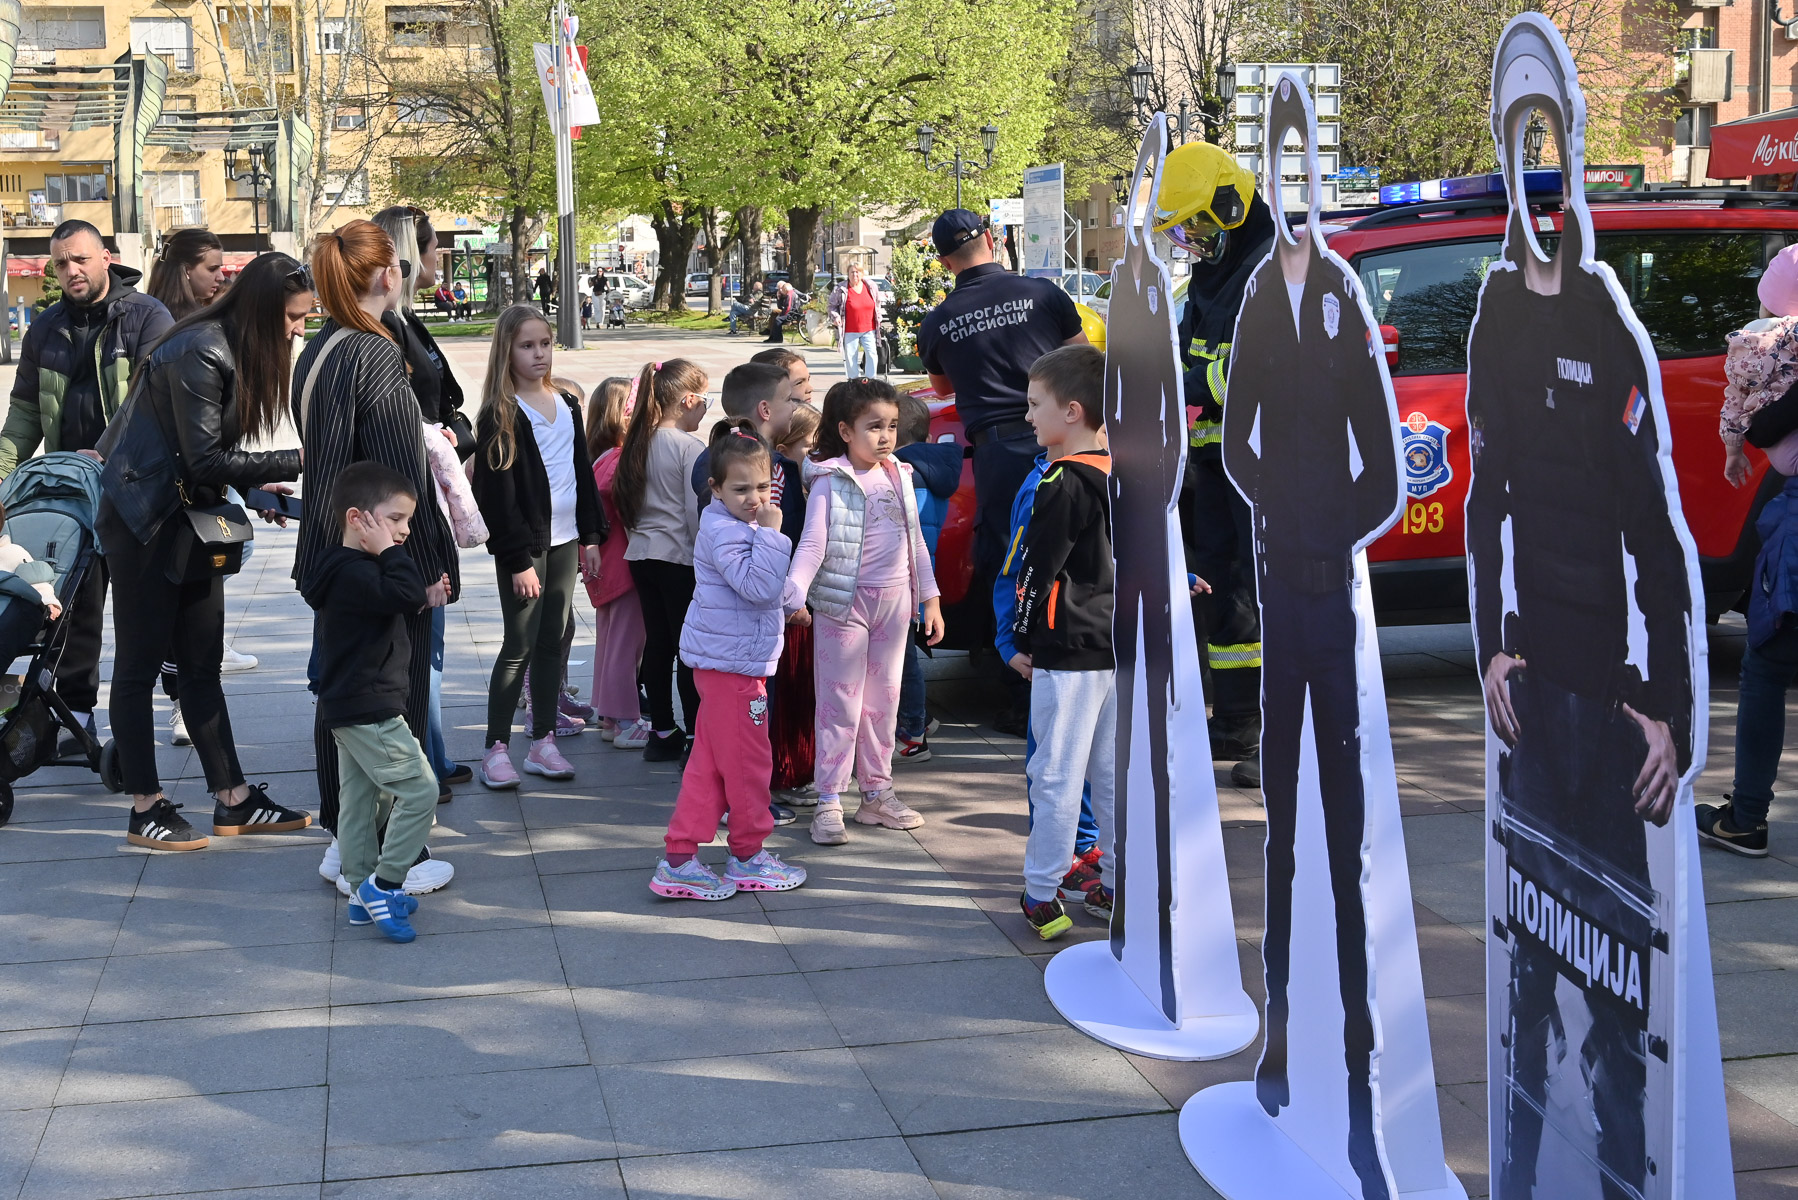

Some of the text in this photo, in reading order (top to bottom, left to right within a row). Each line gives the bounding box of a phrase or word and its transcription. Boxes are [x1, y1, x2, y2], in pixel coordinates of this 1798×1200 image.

[1751, 133, 1779, 166] Moj
[1586, 170, 1624, 182] МИЛОШ
[939, 299, 1034, 335] ВАТРОГАСЦИ
[950, 311, 1028, 342] СПАСИОЦИ
[1556, 357, 1593, 387] ПОЛИЦИЈА
[1402, 502, 1444, 534] 193
[1022, 566, 1034, 596] coose
[1509, 865, 1643, 1010] ПОЛИЦИЈА
